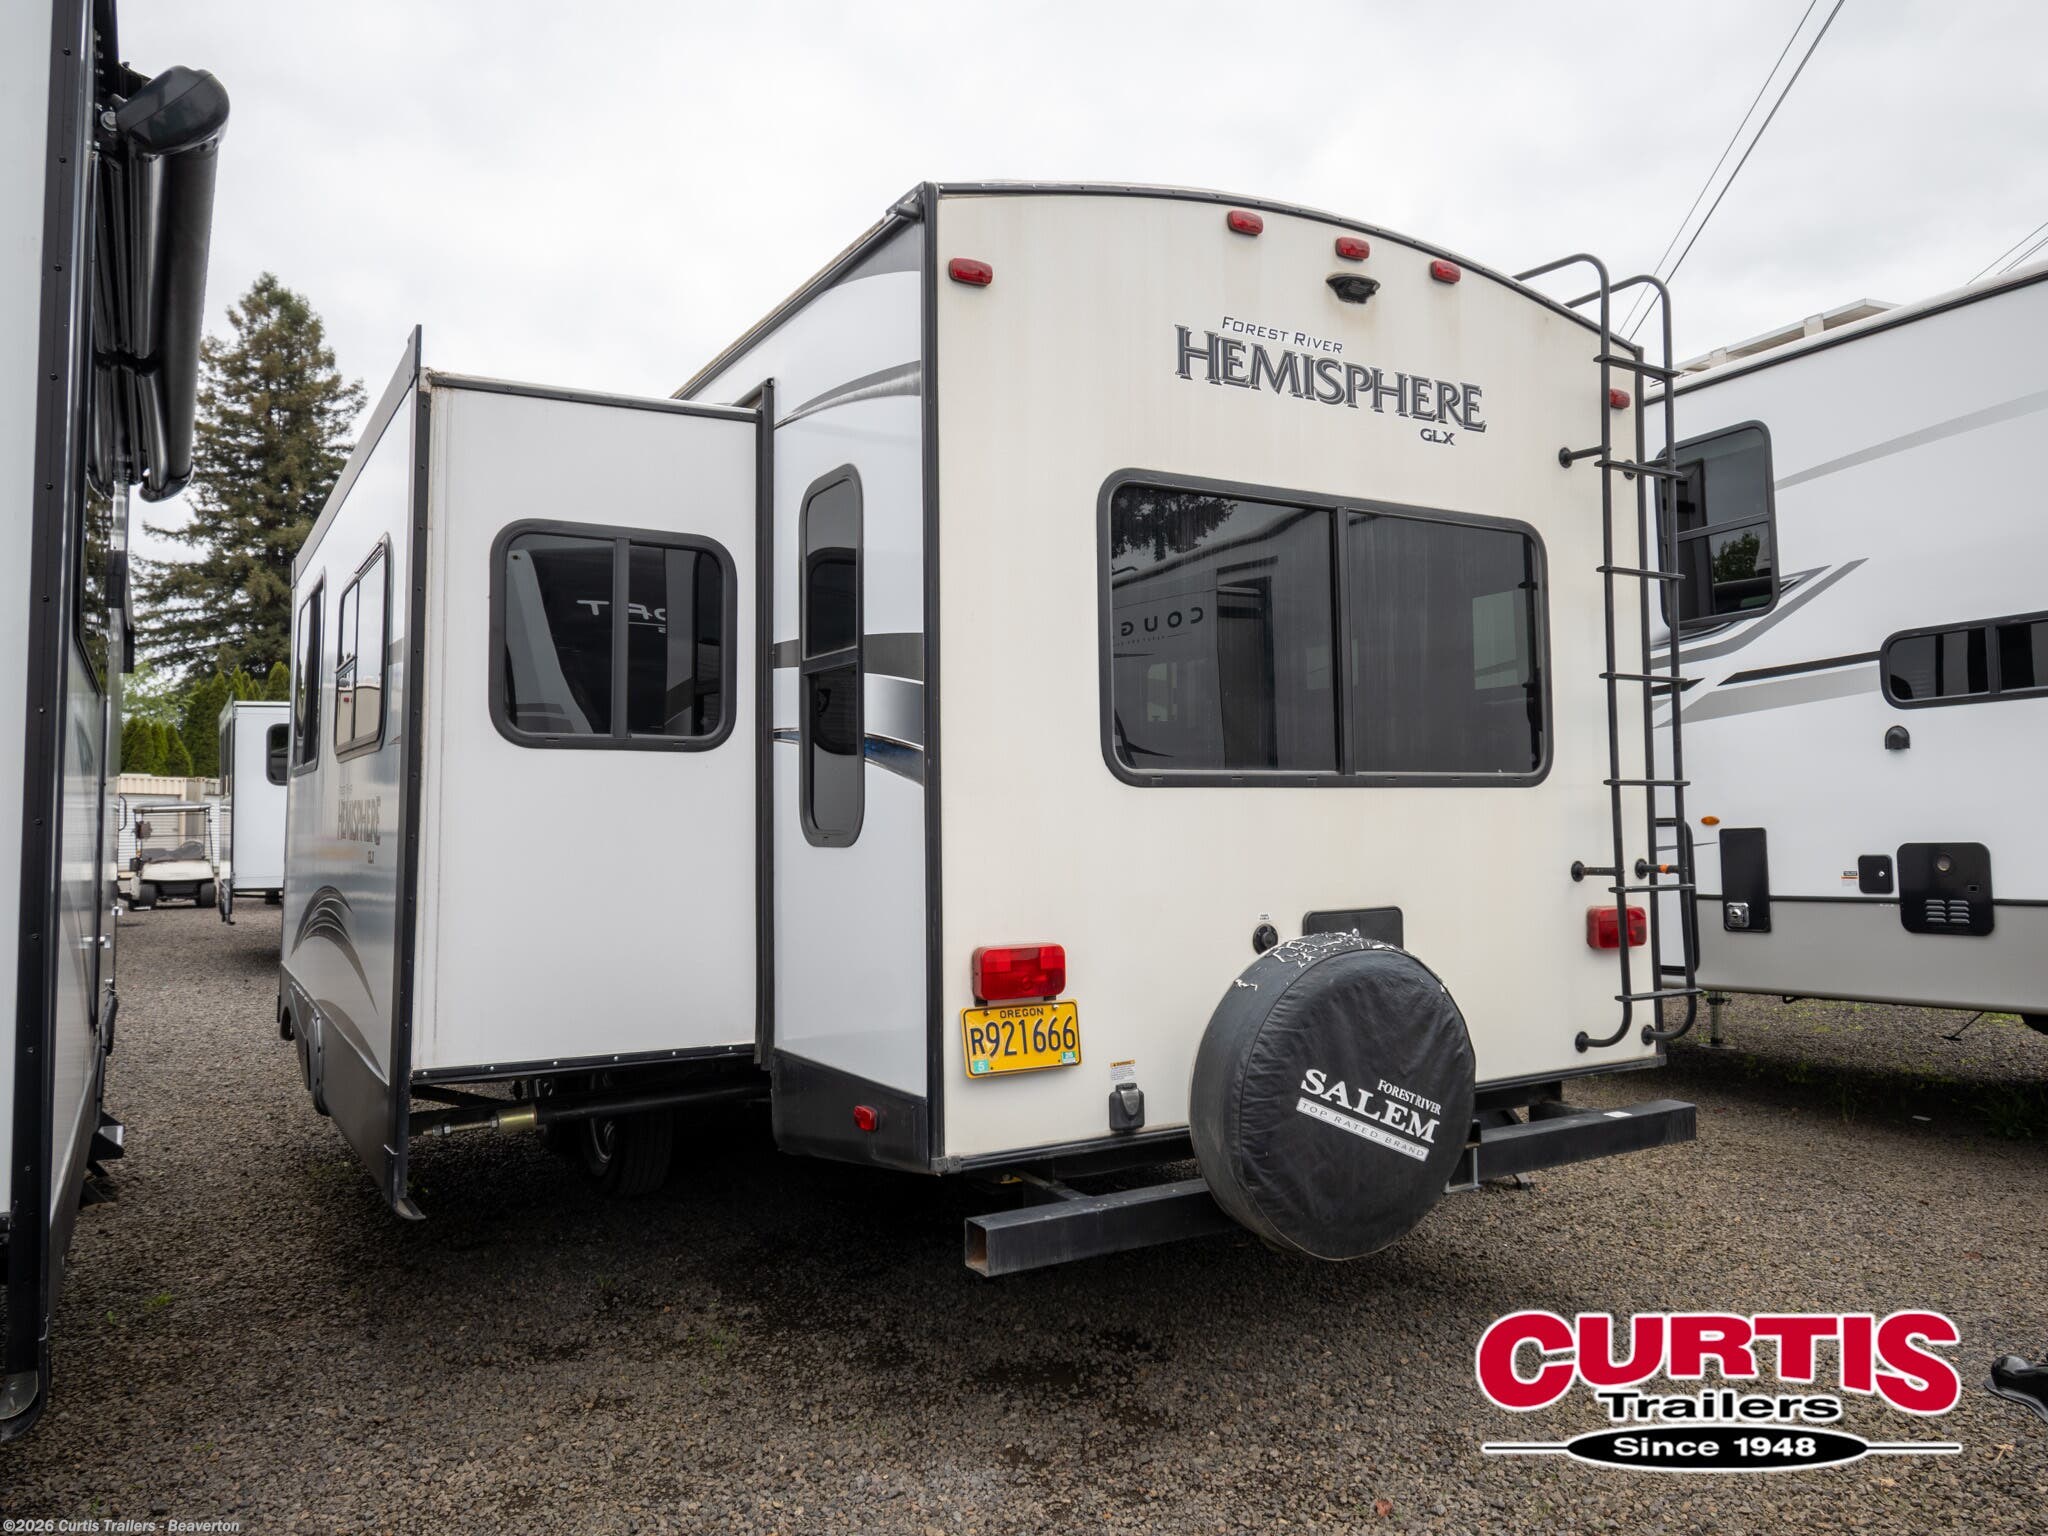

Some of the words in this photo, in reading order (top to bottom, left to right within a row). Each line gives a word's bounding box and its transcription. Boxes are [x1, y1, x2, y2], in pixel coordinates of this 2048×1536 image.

[1222, 316, 1288, 342] FOREST
[1294, 332, 1344, 354] RIVER
[1174, 324, 1488, 433] HEMISPHERE
[1420, 428, 1456, 446] GLX
[1000, 1007, 1044, 1019] OREGON
[970, 1015, 1076, 1058] R921666
[1300, 1068, 1440, 1144] SALEM
[1377, 1078, 1416, 1104] FOREST
[1414, 1094, 1442, 1116] RIVER
[1302, 1102, 1328, 1118] TOP
[1333, 1115, 1379, 1139] RATED
[1384, 1136, 1425, 1158] BRAND
